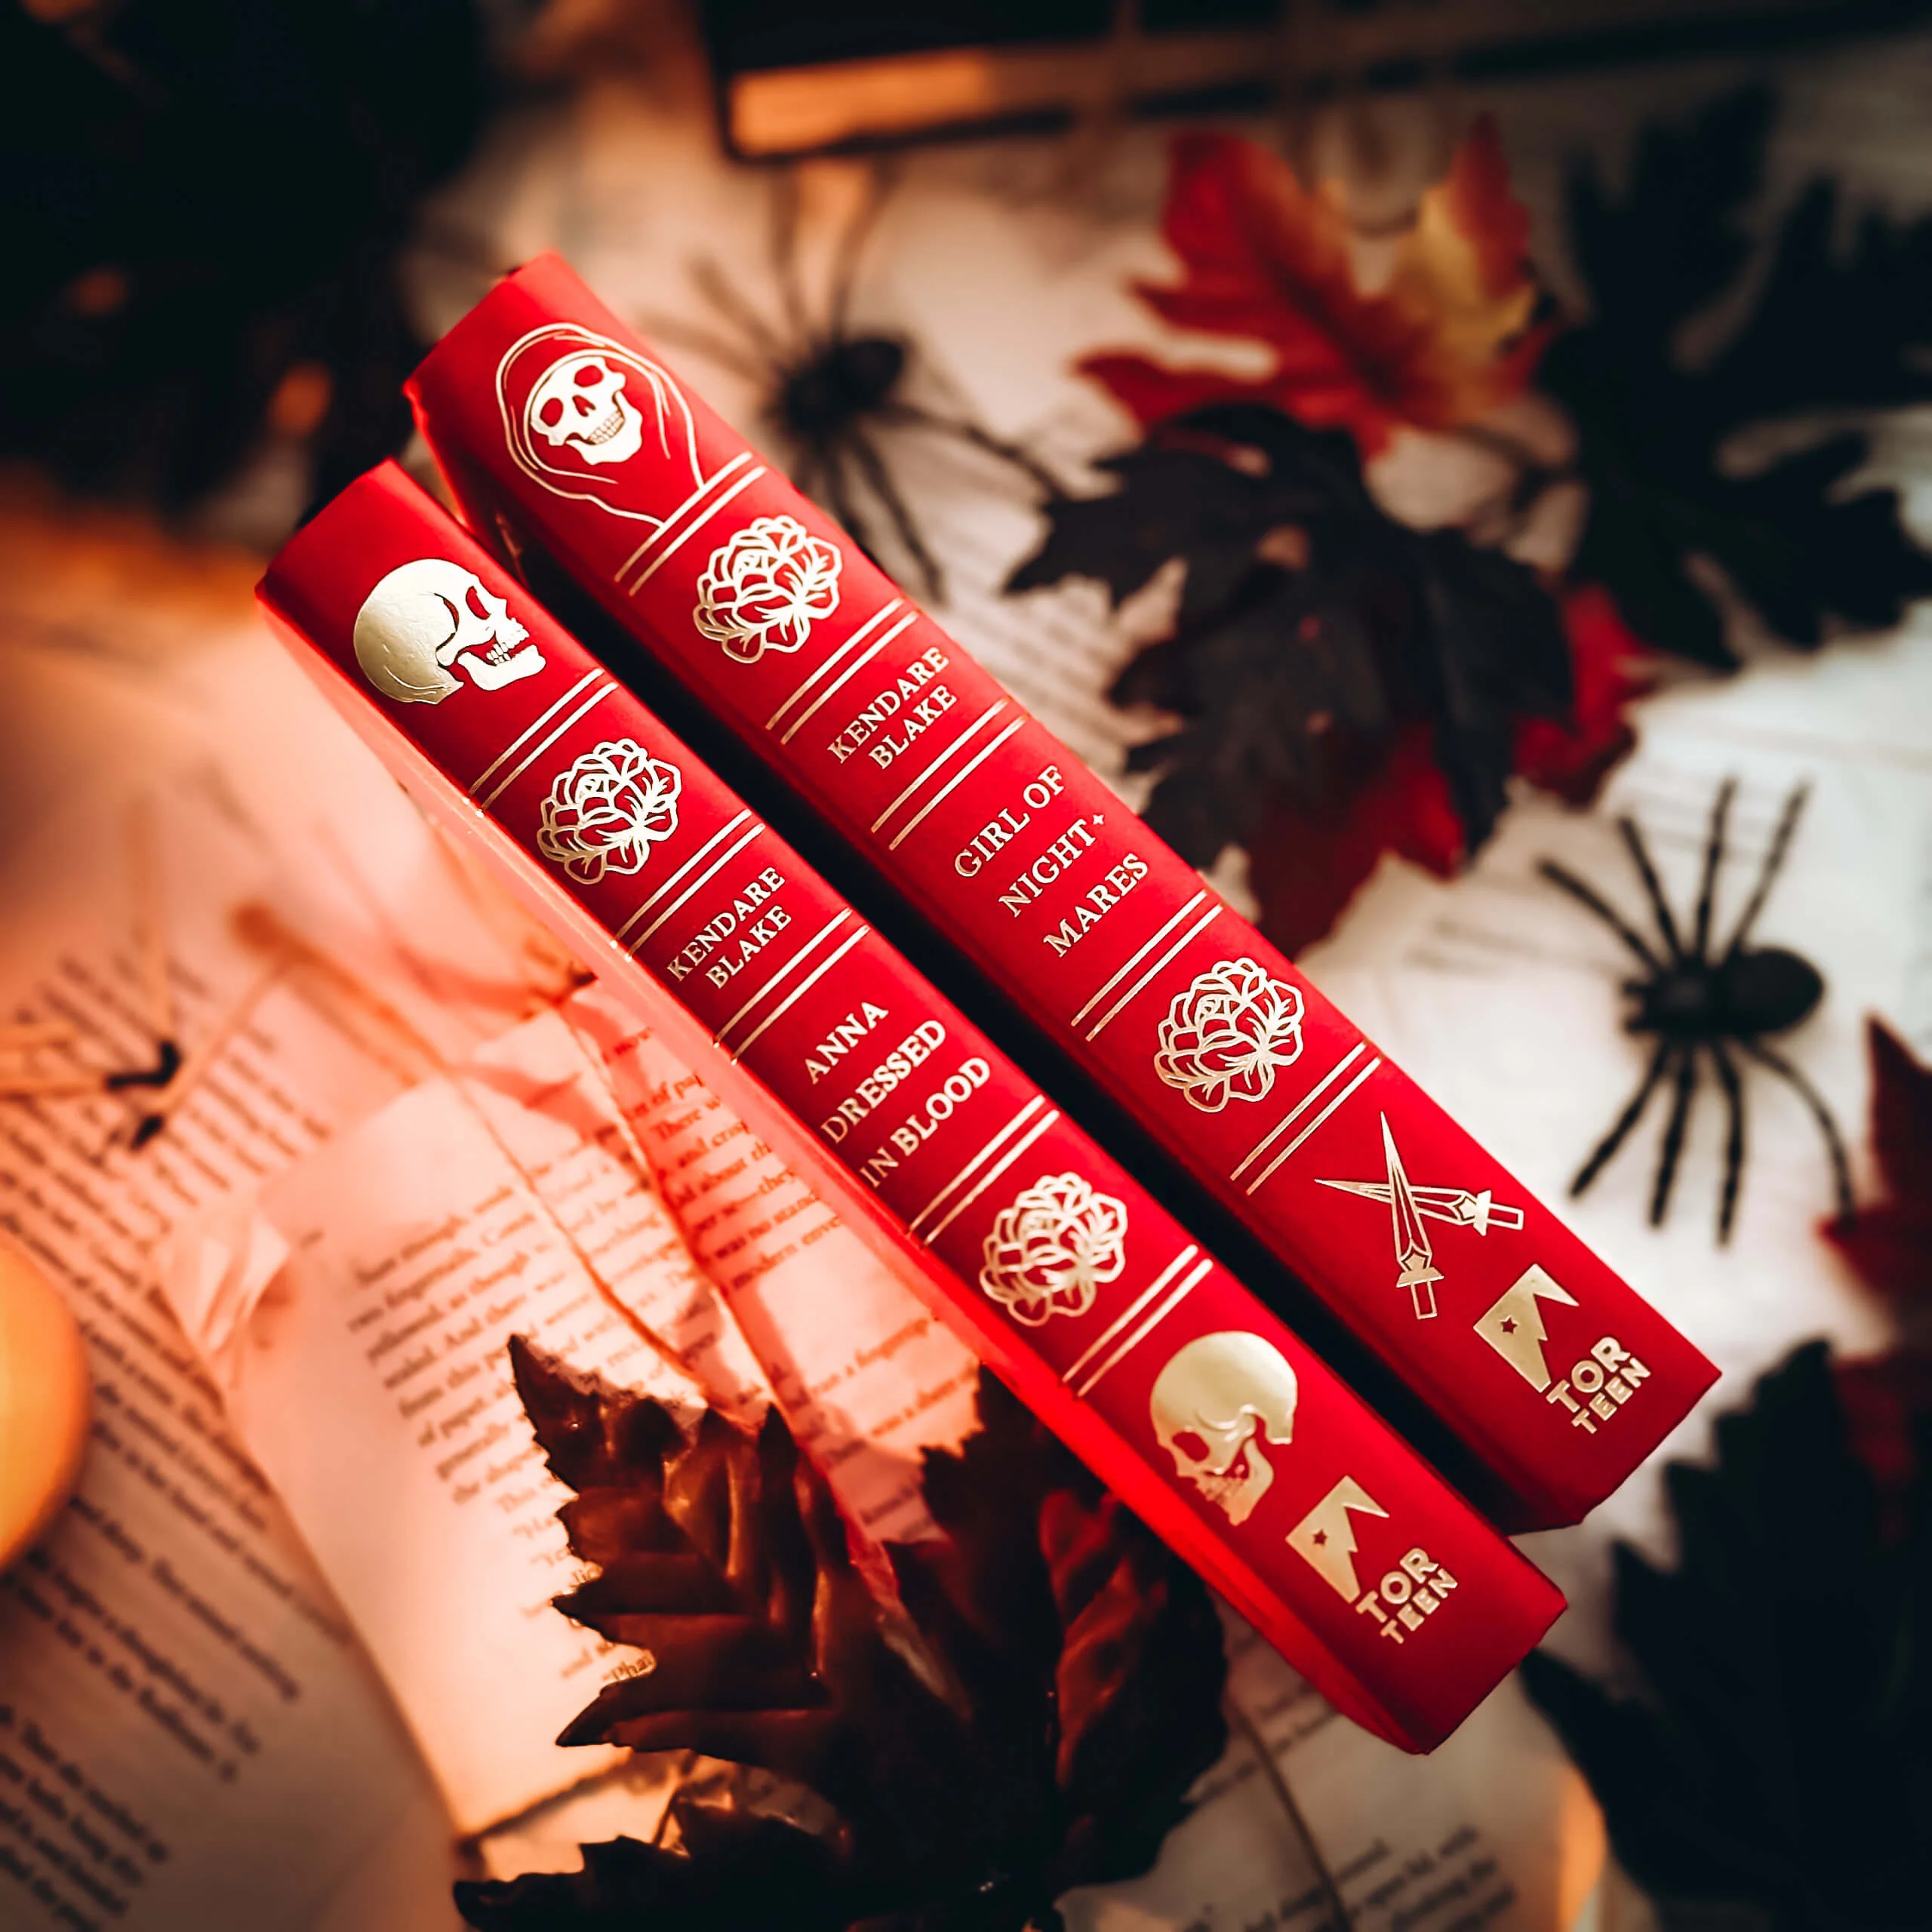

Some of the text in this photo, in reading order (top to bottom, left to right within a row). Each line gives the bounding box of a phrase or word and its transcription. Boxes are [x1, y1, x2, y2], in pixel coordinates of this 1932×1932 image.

[827, 646, 950, 763] KENDARE
[869, 685, 957, 769] BLAKE
[955, 764, 1065, 877] GIRL OF
[667, 867, 785, 980] KENDARE
[706, 906, 791, 989] BLAKE
[1044, 854, 1148, 957] MARES
[806, 1002, 888, 1084] ANNA
[822, 1020, 946, 1142] DRESSED
[861, 1058, 990, 1187] IN BLOOD
[1547, 1337, 1631, 1414] TOR
[1572, 1358, 1651, 1433] TEEN
[1356, 1549, 1438, 1623] TOR
[1381, 1569, 1457, 1644] TEEN
